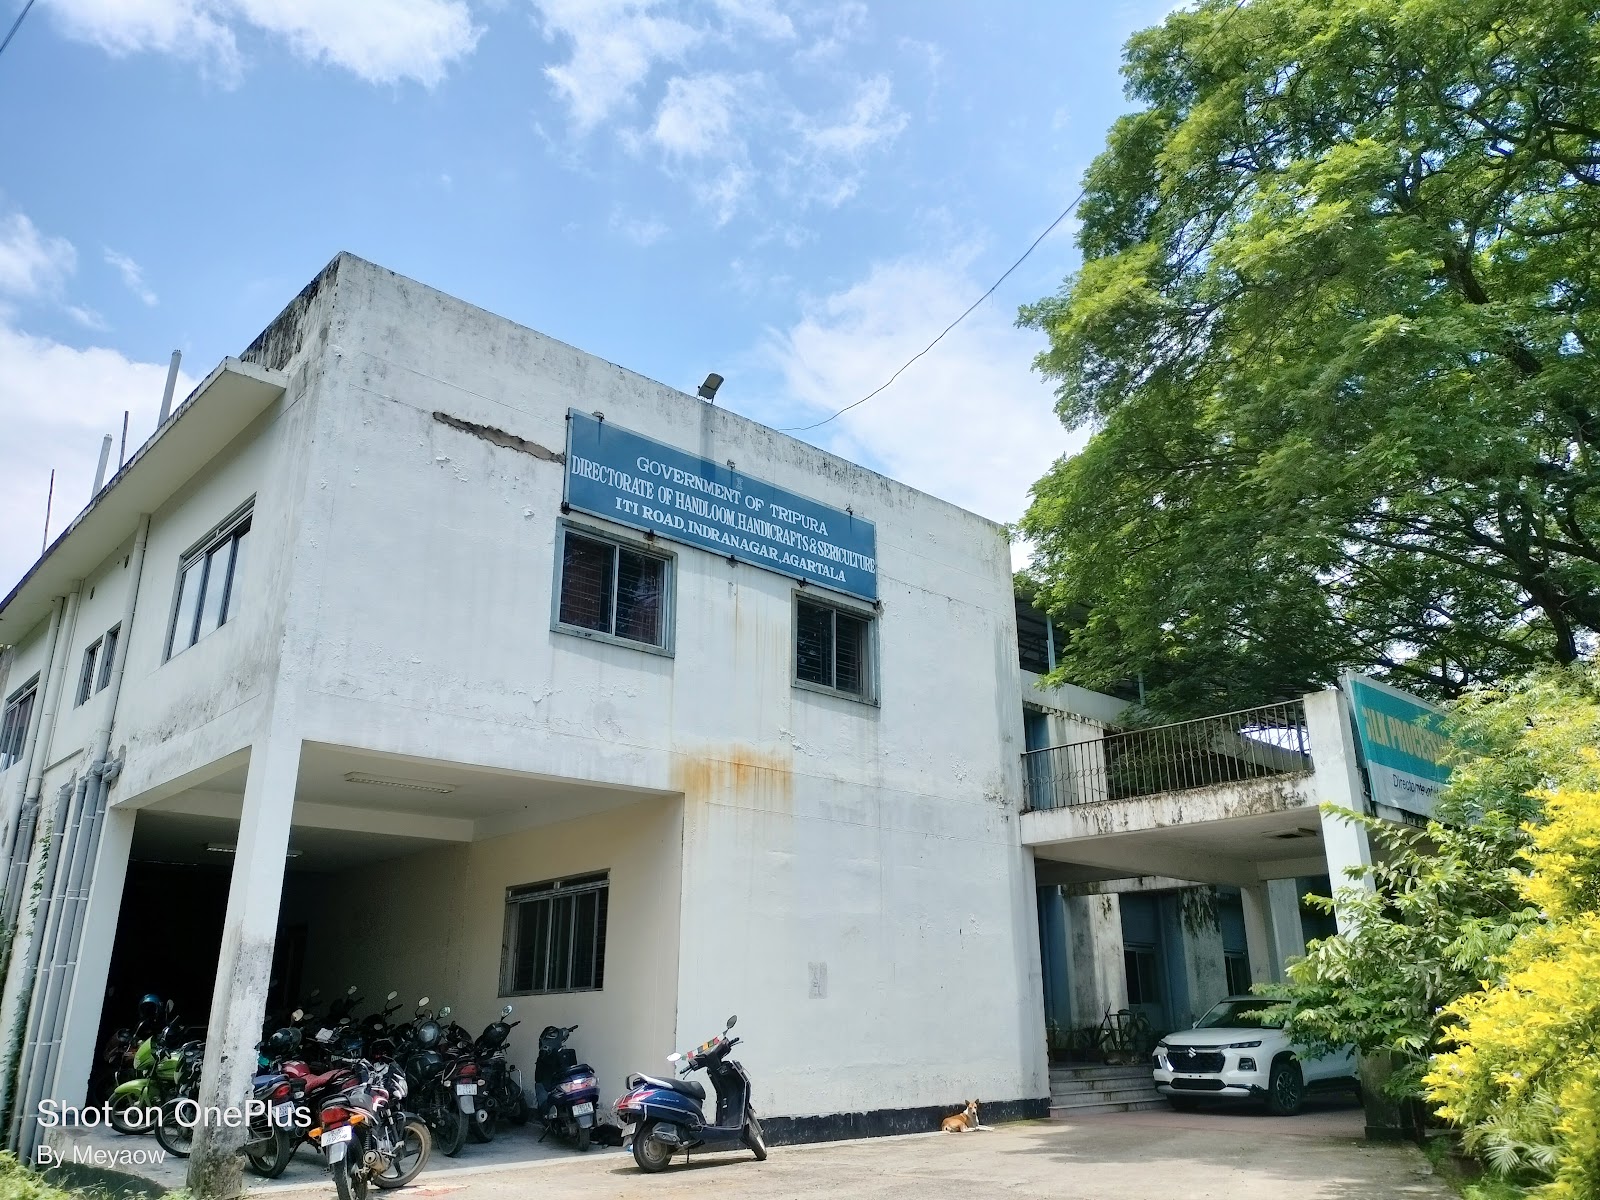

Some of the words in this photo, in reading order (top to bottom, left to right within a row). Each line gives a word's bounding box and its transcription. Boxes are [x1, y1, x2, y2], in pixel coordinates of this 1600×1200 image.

[571, 454, 655, 500] DIRECTORATE
[657, 485, 674, 506] OF
[615, 496, 639, 516] ITI
[636, 456, 742, 505] GOVERNMENT
[744, 495, 765, 512] OF
[769, 503, 829, 537] TRIPURA
